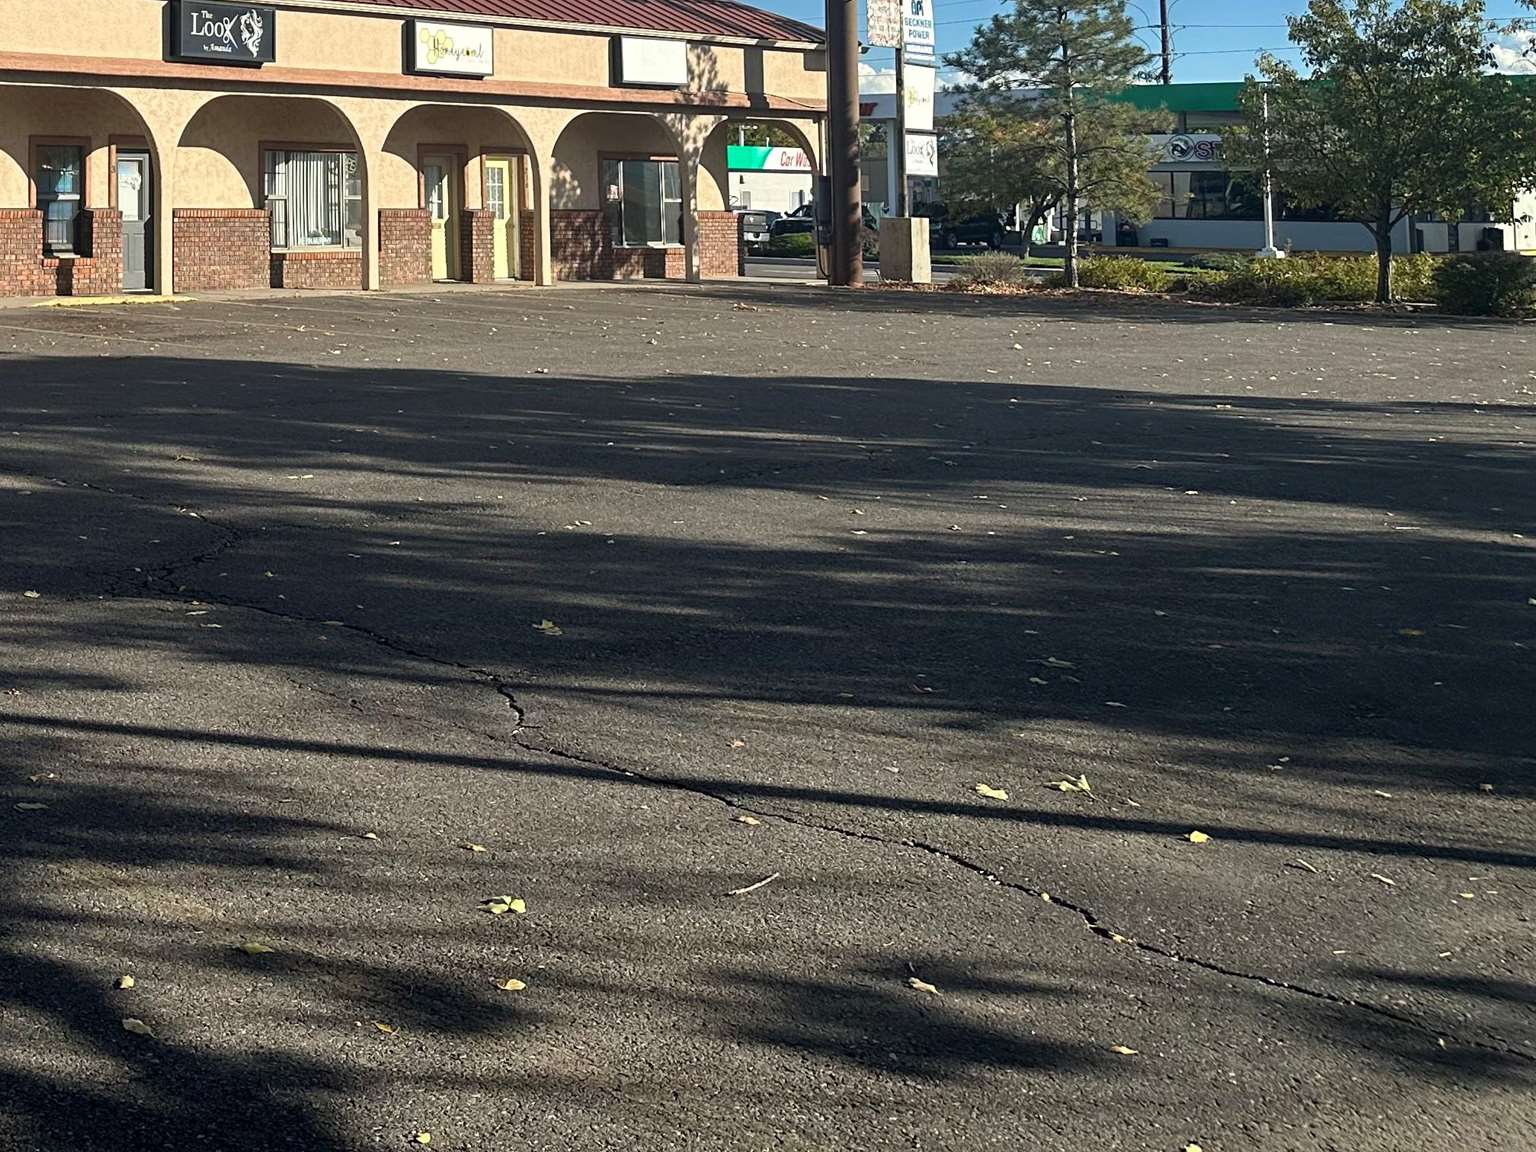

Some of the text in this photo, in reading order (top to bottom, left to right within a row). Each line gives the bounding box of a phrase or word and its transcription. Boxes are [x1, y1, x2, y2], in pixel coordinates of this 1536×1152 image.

[201, 10, 214, 19] The
[908, 29, 930, 40] POWER
[781, 151, 794, 167] Car
